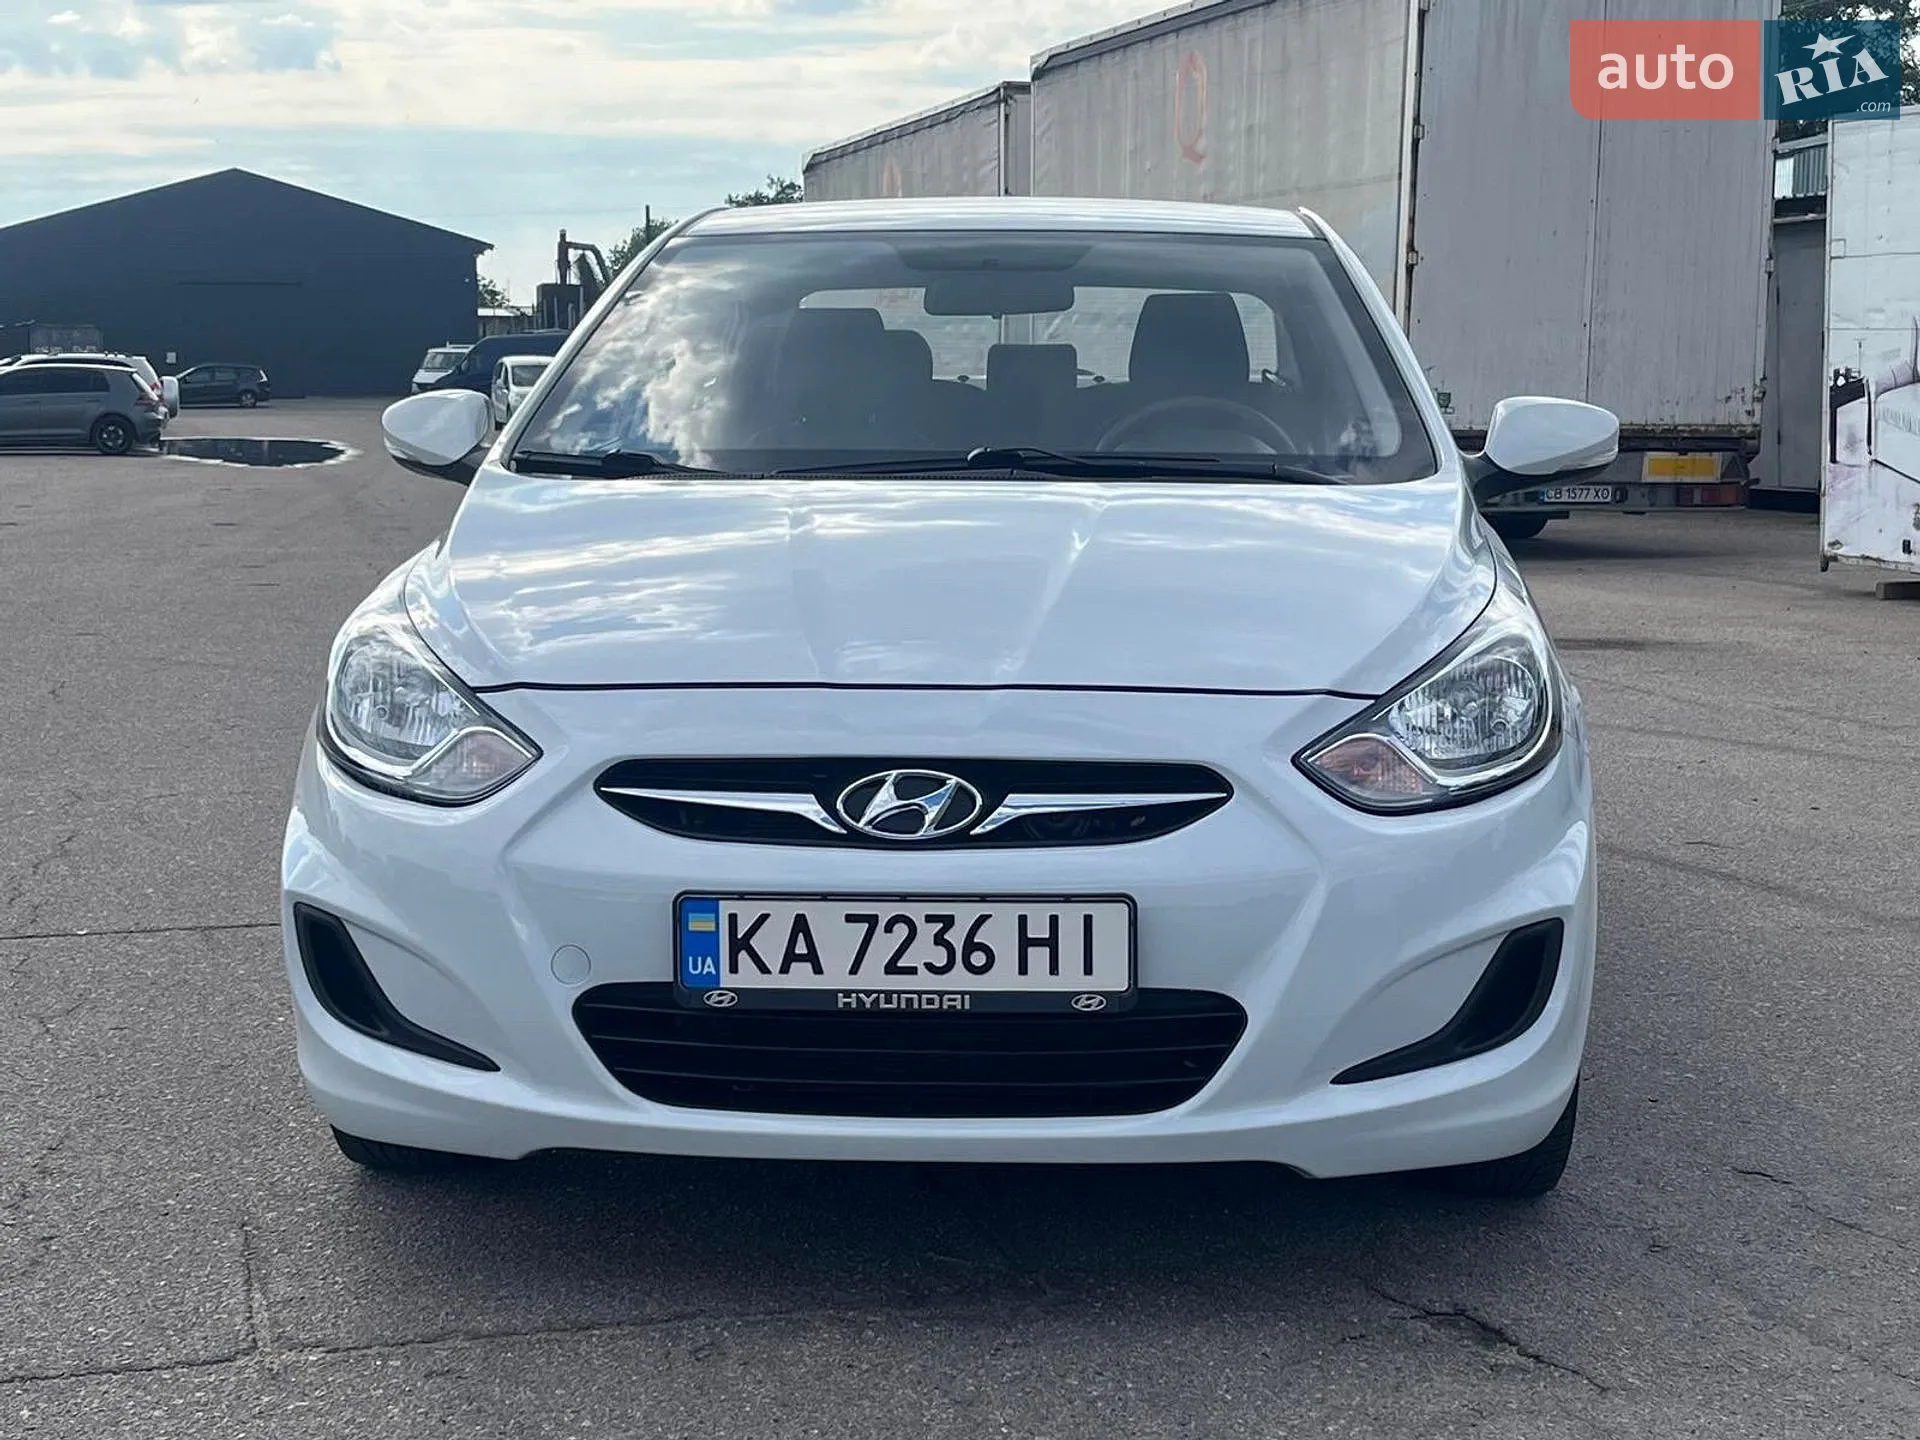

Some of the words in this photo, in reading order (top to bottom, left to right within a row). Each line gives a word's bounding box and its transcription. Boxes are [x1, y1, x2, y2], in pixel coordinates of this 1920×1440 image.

[1567, 487, 1591, 500] 1577
[728, 912, 825, 975] KA
[844, 913, 996, 976] 7236
[1017, 913, 1094, 976] HI
[688, 956, 716, 975] UA
[837, 992, 970, 1010] HYUNDAI
